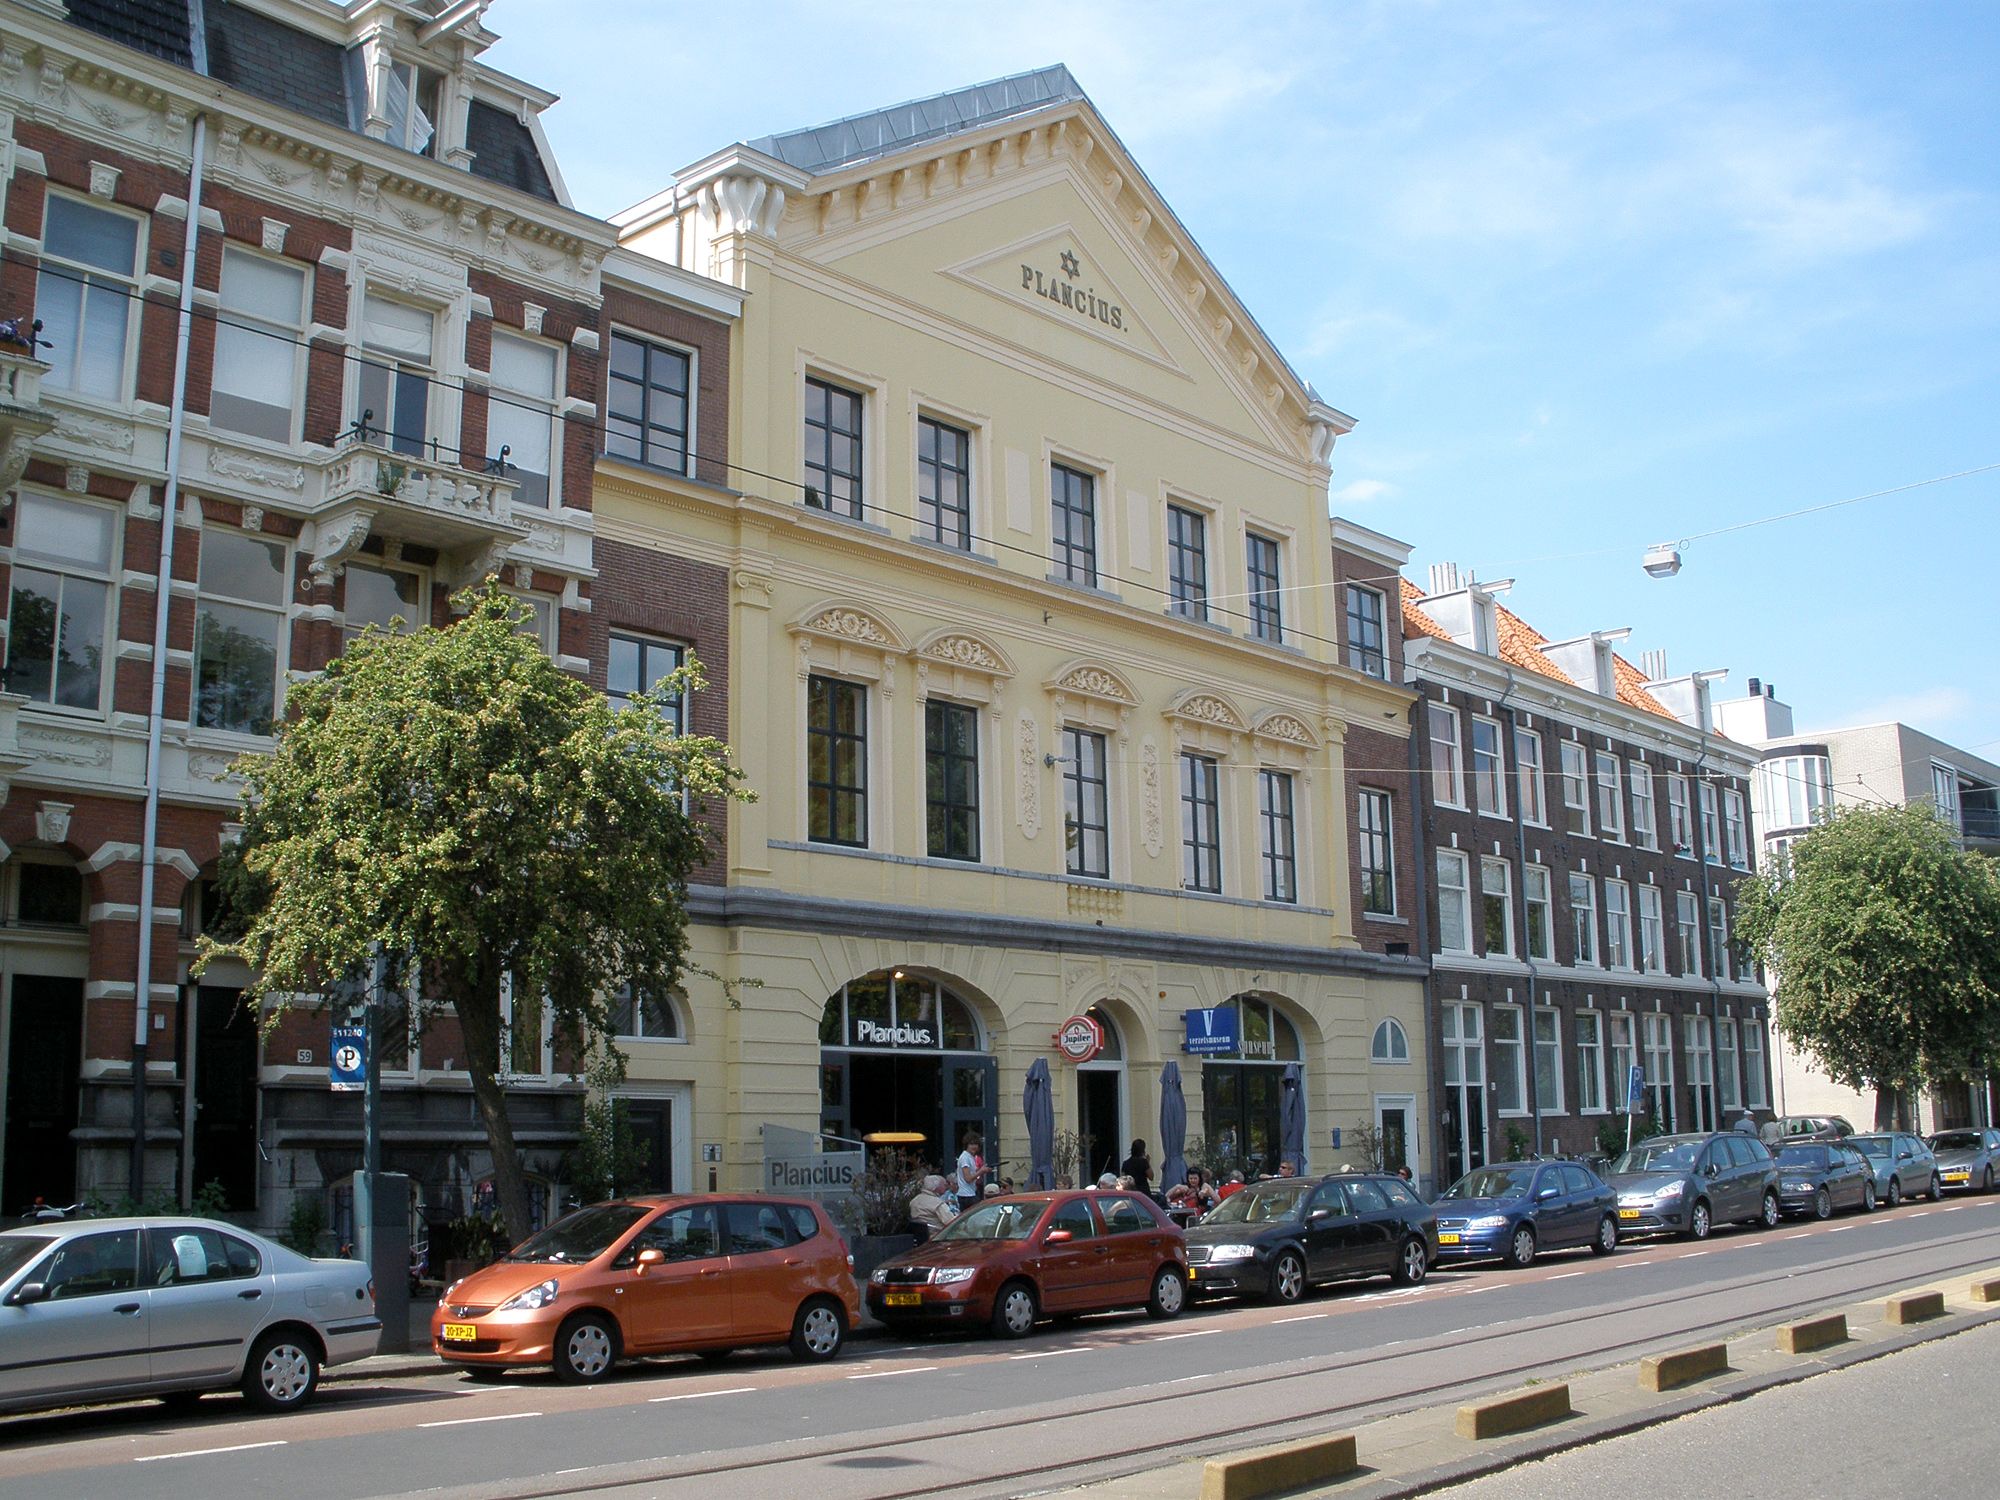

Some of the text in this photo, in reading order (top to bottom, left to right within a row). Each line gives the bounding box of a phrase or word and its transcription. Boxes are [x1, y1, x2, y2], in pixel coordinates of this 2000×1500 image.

[1203, 1010, 1214, 1036] V
[1064, 1034, 1091, 1044] Jupiler
[300, 1051, 311, 1061] 59
